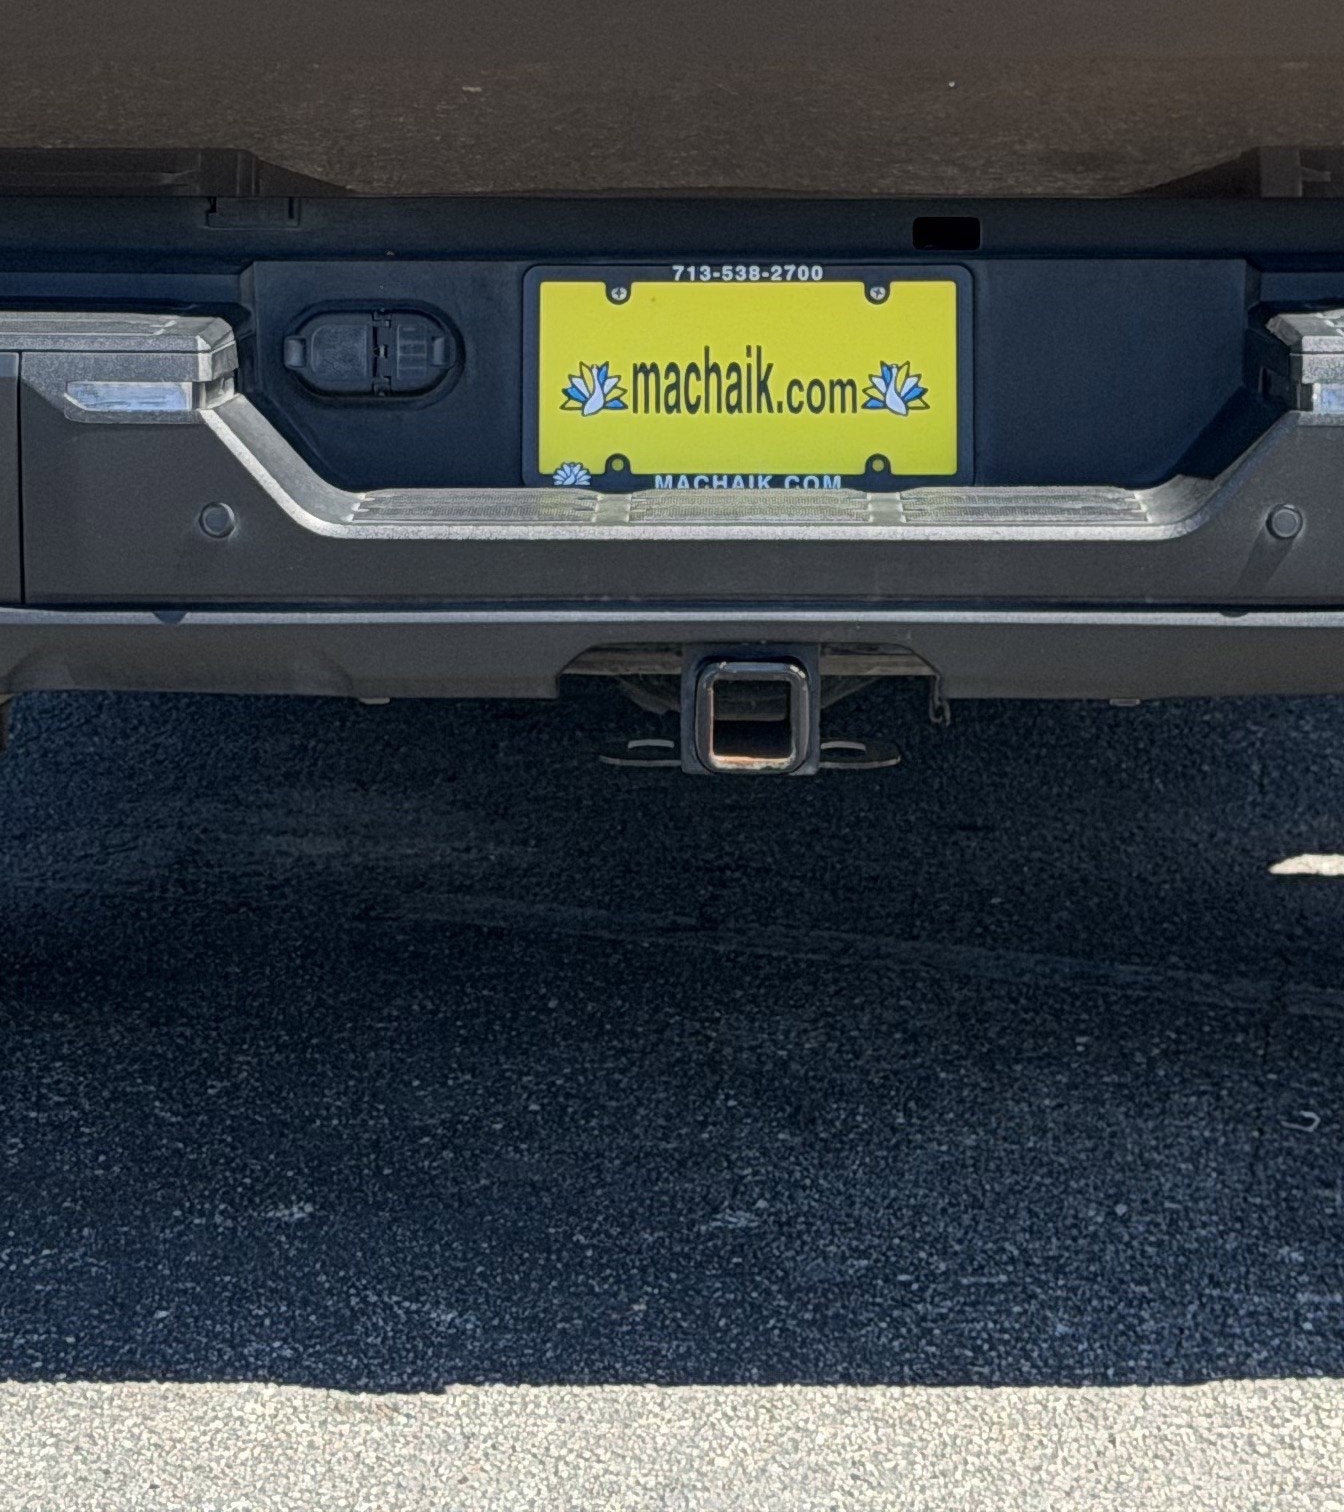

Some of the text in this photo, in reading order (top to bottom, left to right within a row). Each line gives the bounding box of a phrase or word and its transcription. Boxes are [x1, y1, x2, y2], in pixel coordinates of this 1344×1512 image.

[672, 264, 823, 282] 713-538-2700
[632, 345, 857, 414] machaik.com
[655, 474, 843, 489] MACHAIKCOM
